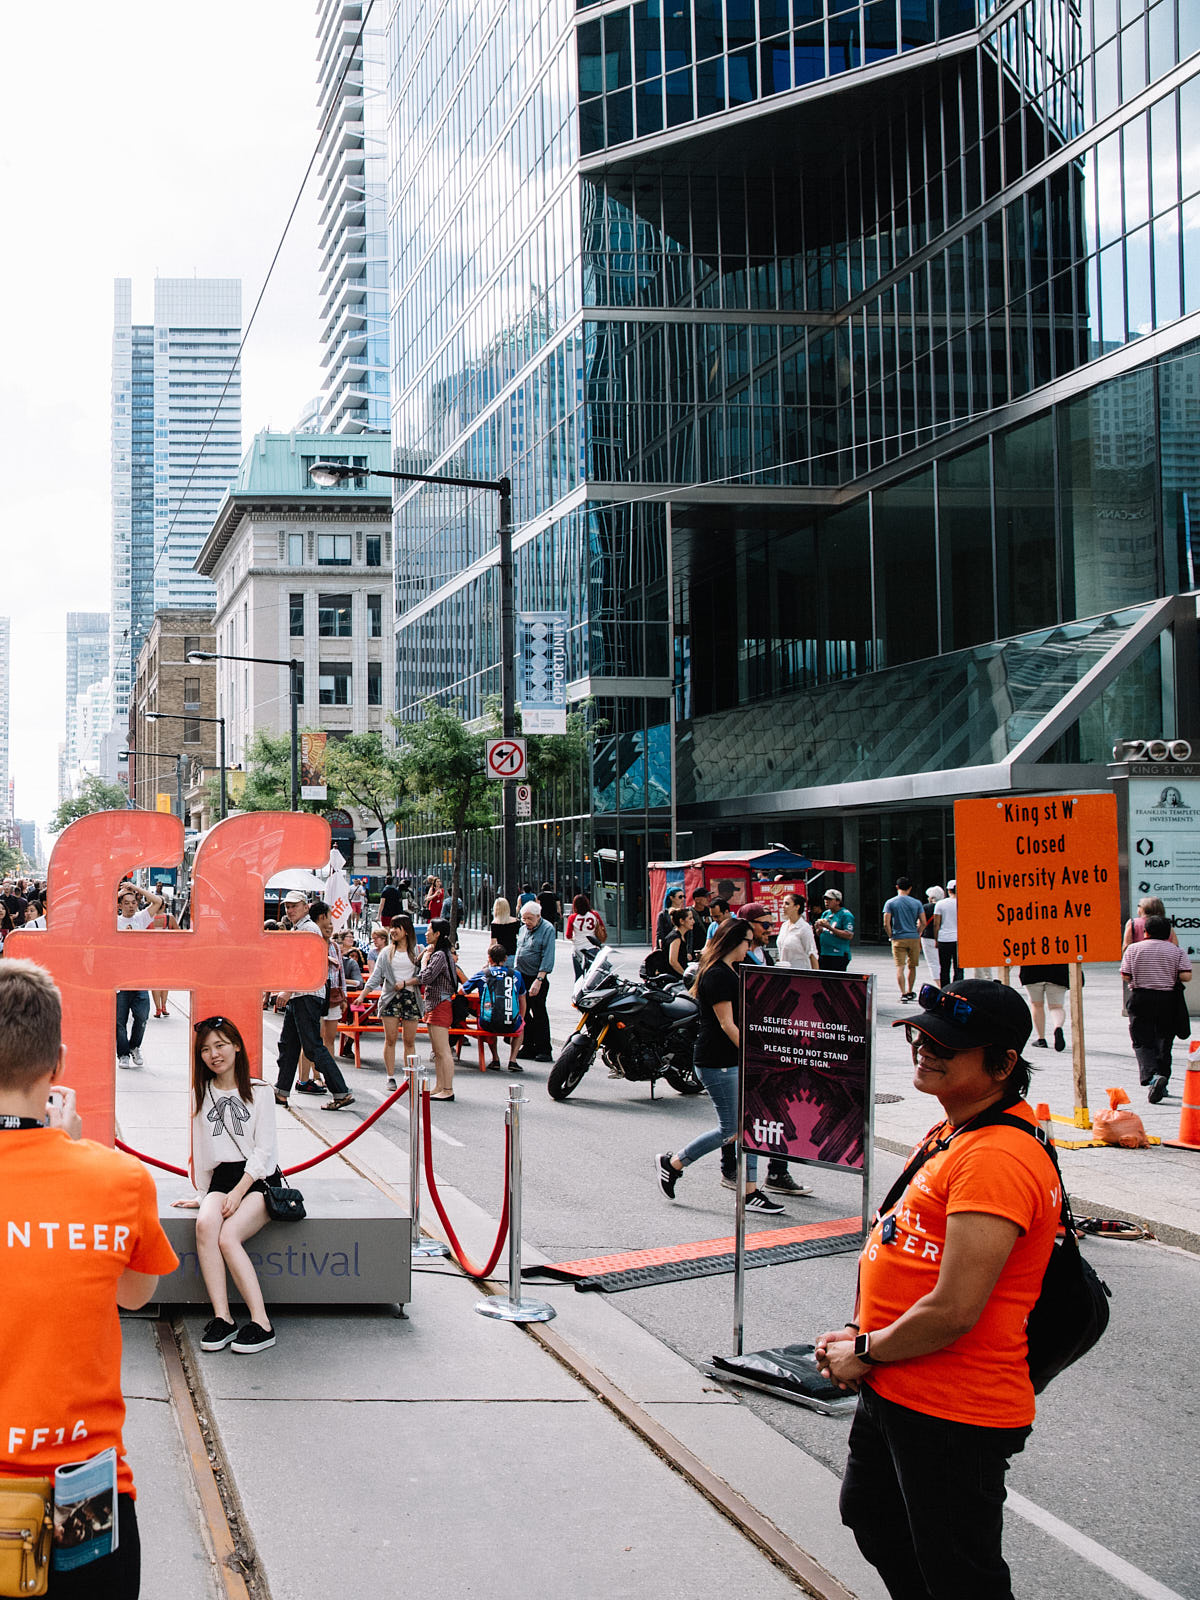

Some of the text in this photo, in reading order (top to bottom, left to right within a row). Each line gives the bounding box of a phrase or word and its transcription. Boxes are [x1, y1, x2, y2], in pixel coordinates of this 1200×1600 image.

[553, 617, 565, 705] OPPORTUNITY
[1122, 739, 1192, 761] 200
[1131, 765, 1159, 774] KING
[1004, 800, 1074, 827] King st W
[1016, 834, 1066, 855] Closed
[1144, 860, 1170, 868] MCAP
[976, 864, 1108, 890] University Ave to
[996, 899, 1091, 926] Spadina Ave
[576, 917, 596, 931] 73
[1003, 934, 1088, 960] Sept 8 to 11
[504, 976, 513, 1025] HEAD
[763, 1016, 792, 1026] SELFIES
[794, 1019, 808, 1027] ARE
[749, 1024, 866, 1043] STANDING ON THE SIGN IS NOT.
[763, 1044, 849, 1061] PLEASE DO NOT STAND
[780, 1055, 831, 1069] ON THE SIGN.
[753, 1118, 784, 1145] tiff
[249, 1242, 360, 1277] estival
